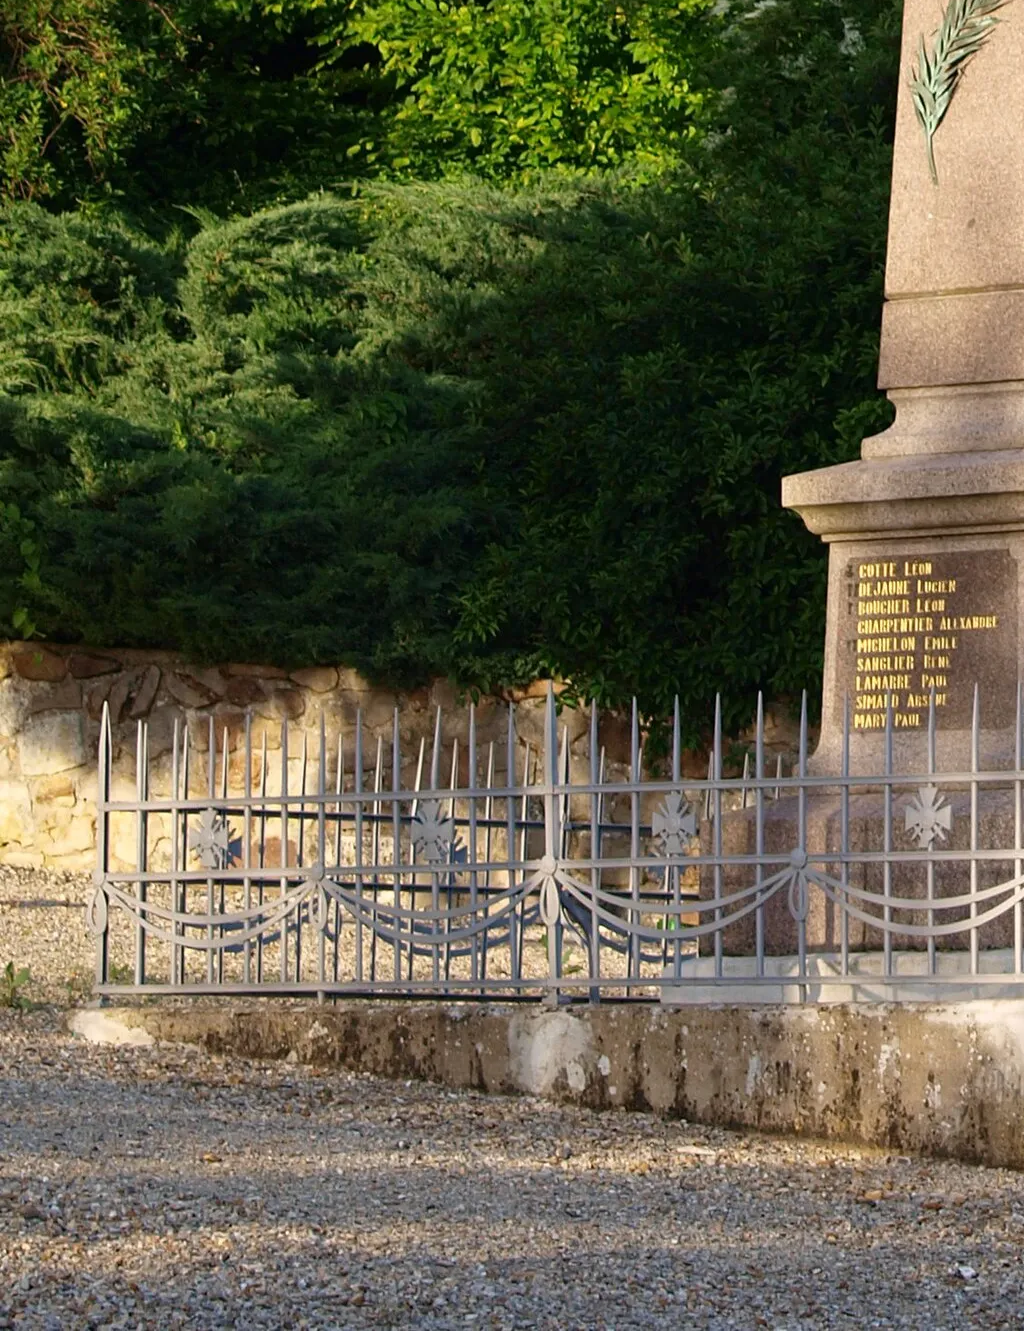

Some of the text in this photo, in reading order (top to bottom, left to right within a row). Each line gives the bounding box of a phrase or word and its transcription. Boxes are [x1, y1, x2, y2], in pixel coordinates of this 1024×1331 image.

[859, 562, 896, 578] COTTE
[917, 579, 957, 594] LUCIEN
[858, 598, 910, 616] BOUCHER
[857, 615, 998, 635] CHARPENTIER ALEXANDRE
[857, 635, 916, 653] MICHELON
[857, 655, 914, 672] SANGLIER
[855, 674, 911, 691] LAMARRE
[854, 712, 921, 728] MARY PAUL
